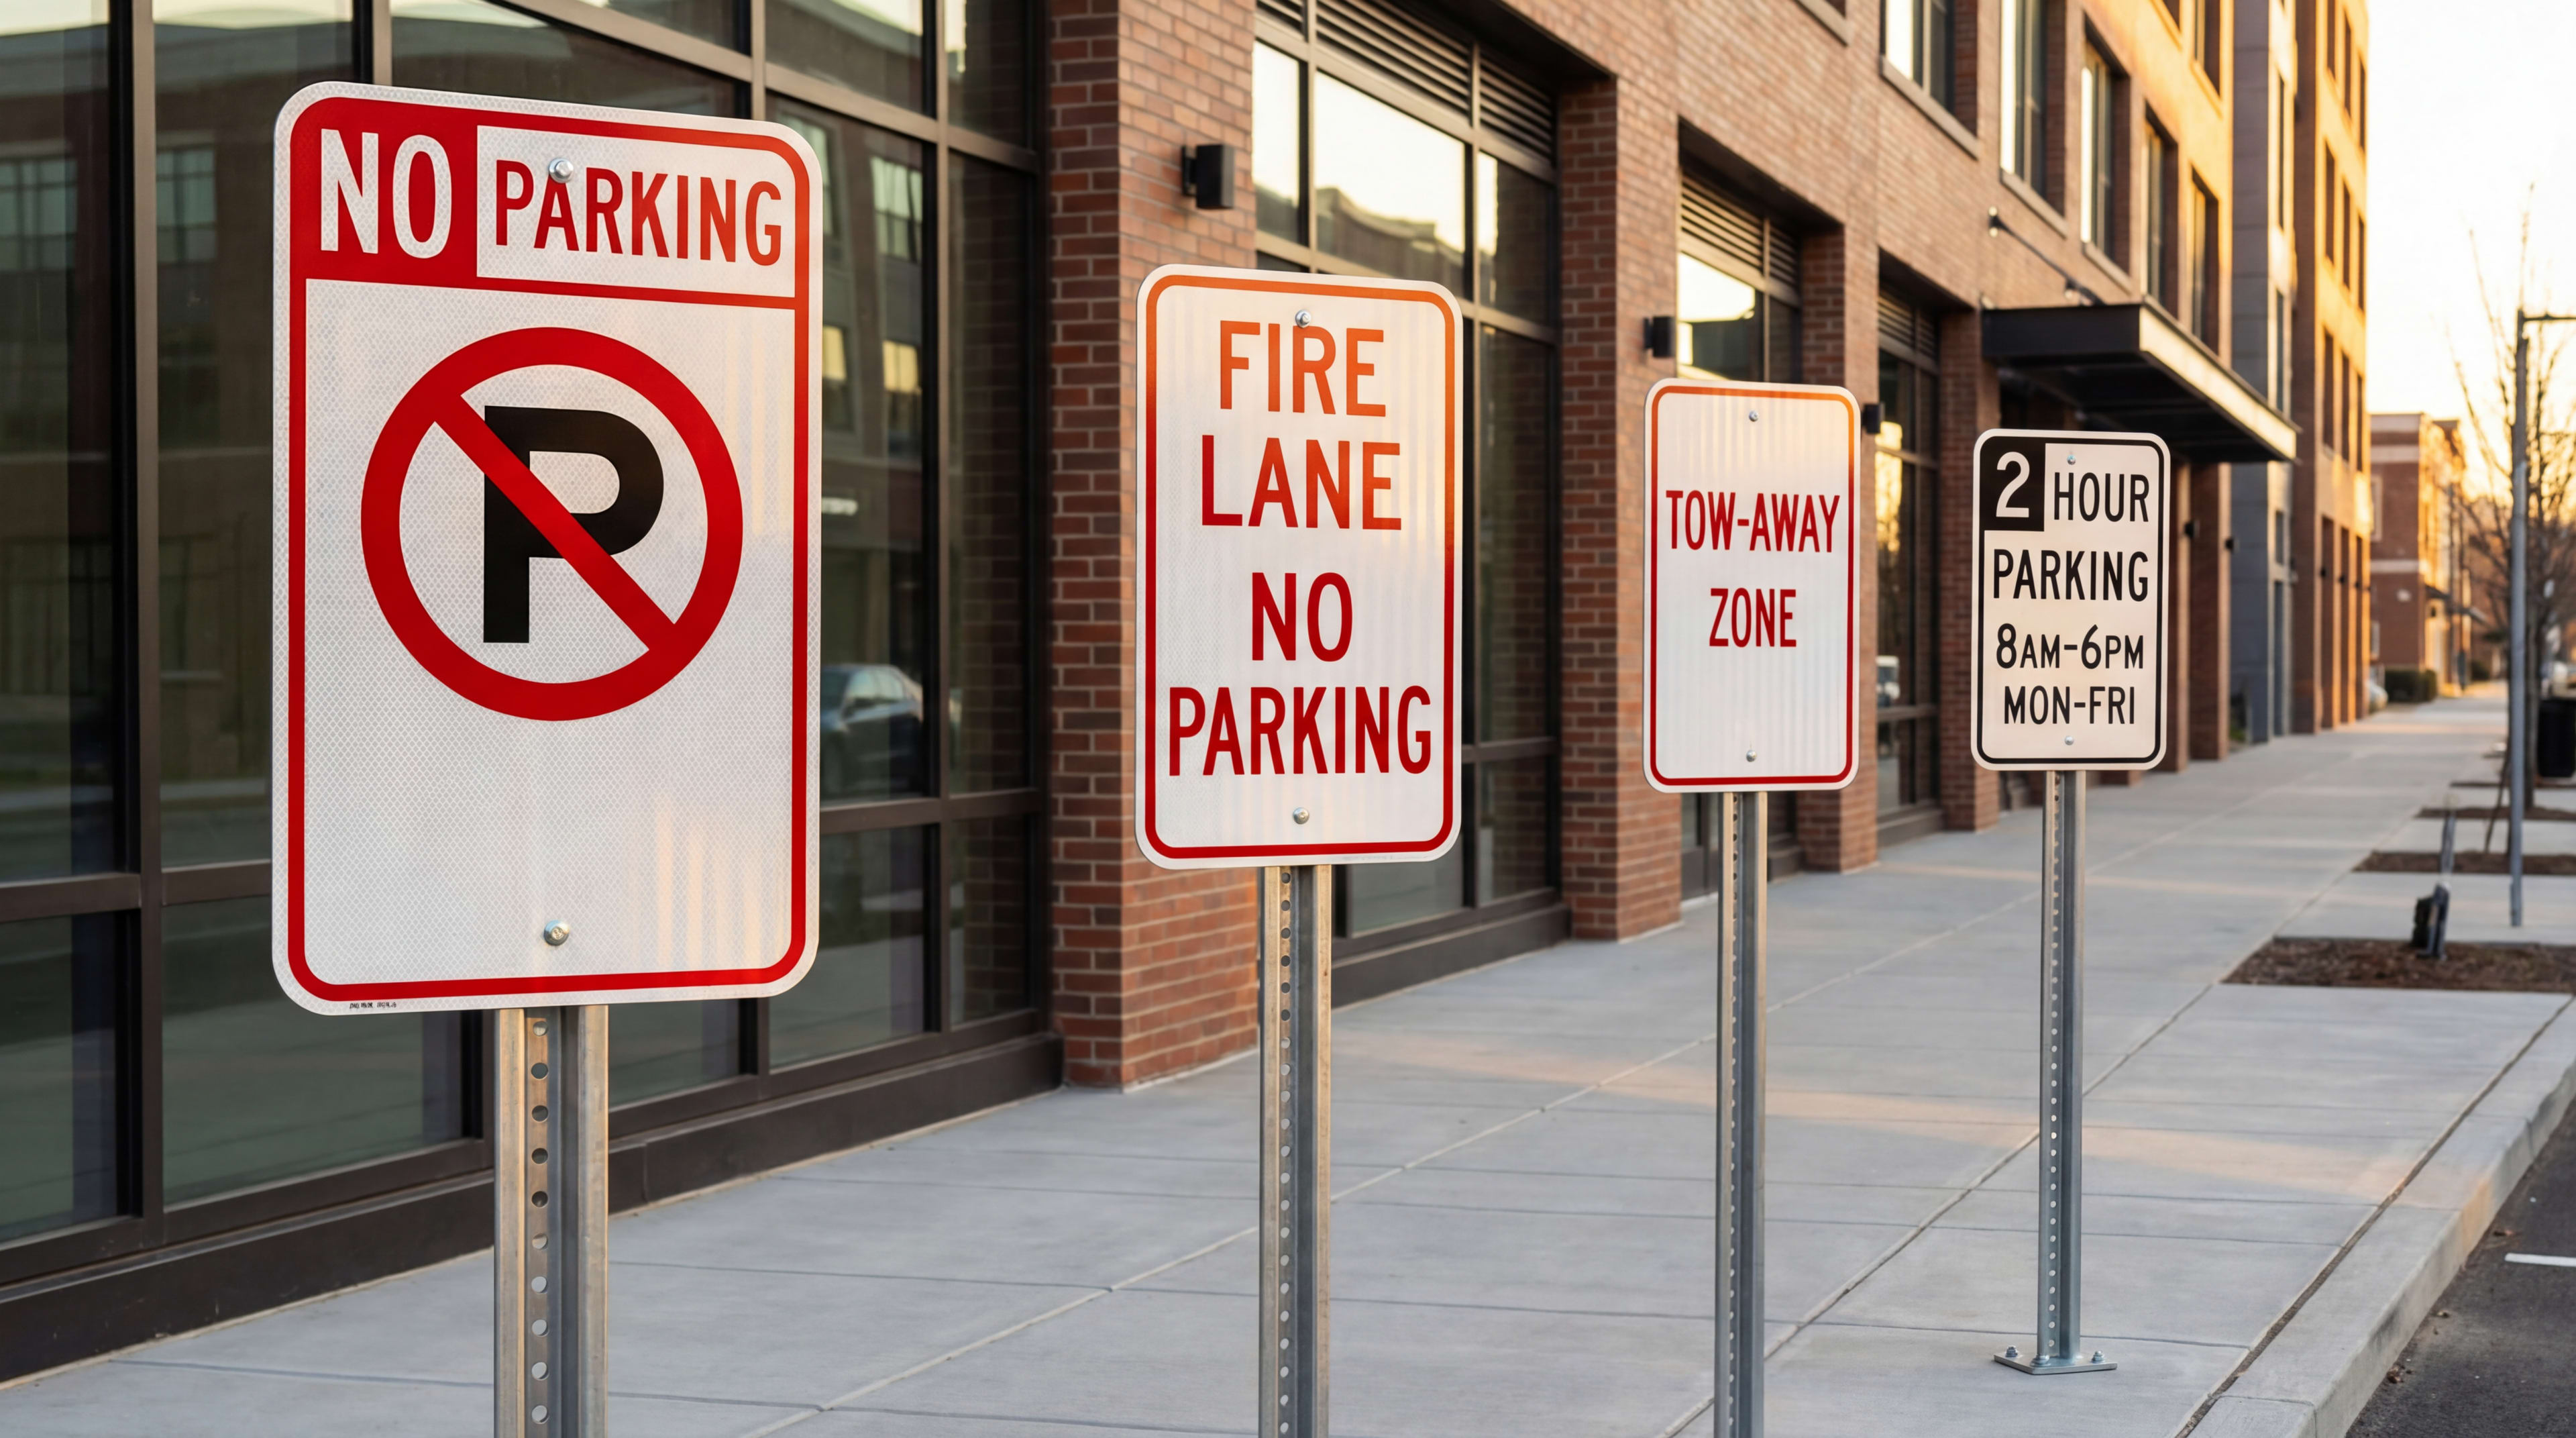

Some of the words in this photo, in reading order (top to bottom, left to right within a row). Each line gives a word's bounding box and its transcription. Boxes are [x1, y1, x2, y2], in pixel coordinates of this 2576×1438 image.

[321, 129, 452, 259] NO
[496, 159, 782, 266] PARKING
[1220, 320, 1387, 417] FIRE
[1201, 434, 1401, 531] LANE
[1996, 451, 2030, 518] 2
[2053, 472, 2149, 523] HOUR
[1666, 490, 1840, 553] TOW-AWAY
[1993, 549, 2149, 602] PARKING
[1252, 572, 1353, 662] NO
[1709, 587, 1797, 648] ZONE
[1996, 623, 2144, 670] 8AM-6PM
[1169, 685, 1432, 776] PARKING
[2003, 685, 2135, 725] MON-FRI
